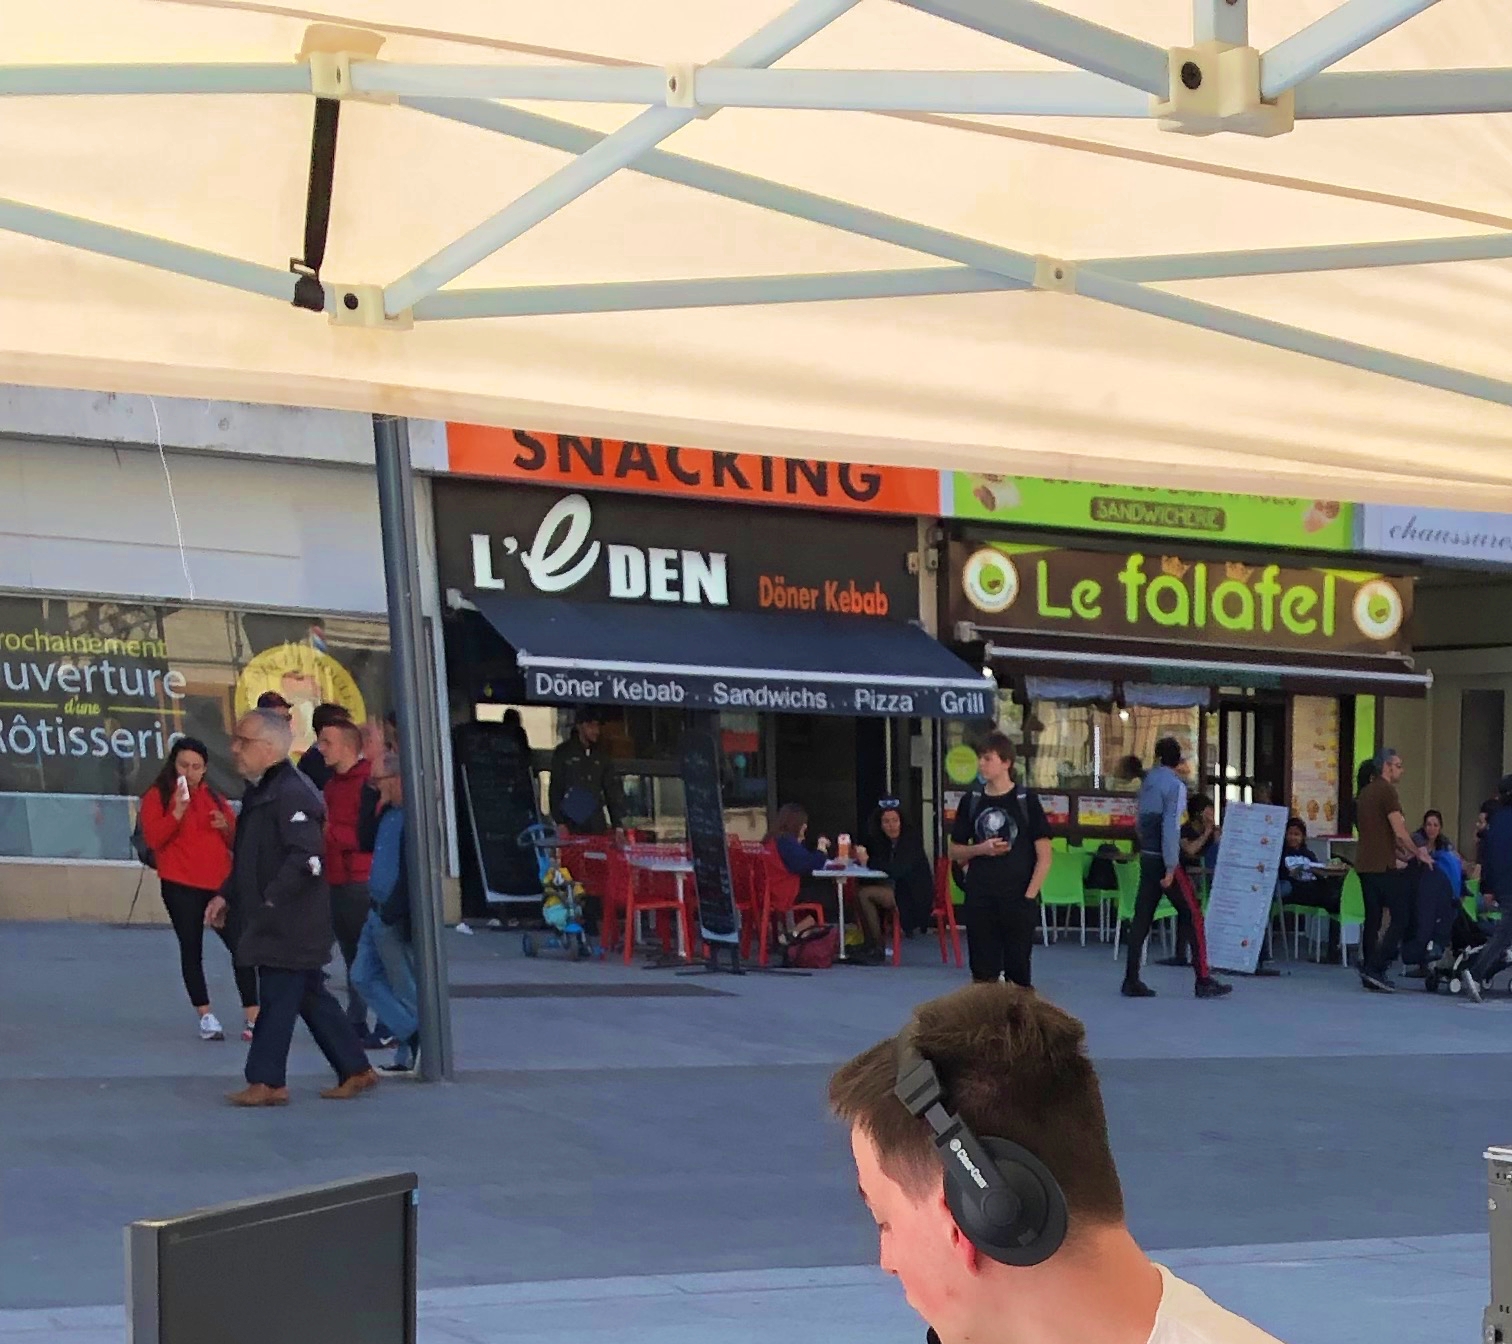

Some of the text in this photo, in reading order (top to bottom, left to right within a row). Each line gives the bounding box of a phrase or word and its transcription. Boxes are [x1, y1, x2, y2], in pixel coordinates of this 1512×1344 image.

[512, 428, 881, 501] SNACKING
[759, 575, 889, 616] Döner Kebab
[1036, 553, 1336, 636] Le falafel
[64, 696, 101, 715] d'une
[535, 672, 985, 714] Döner Kebab Sandwichs Pizza Grill
